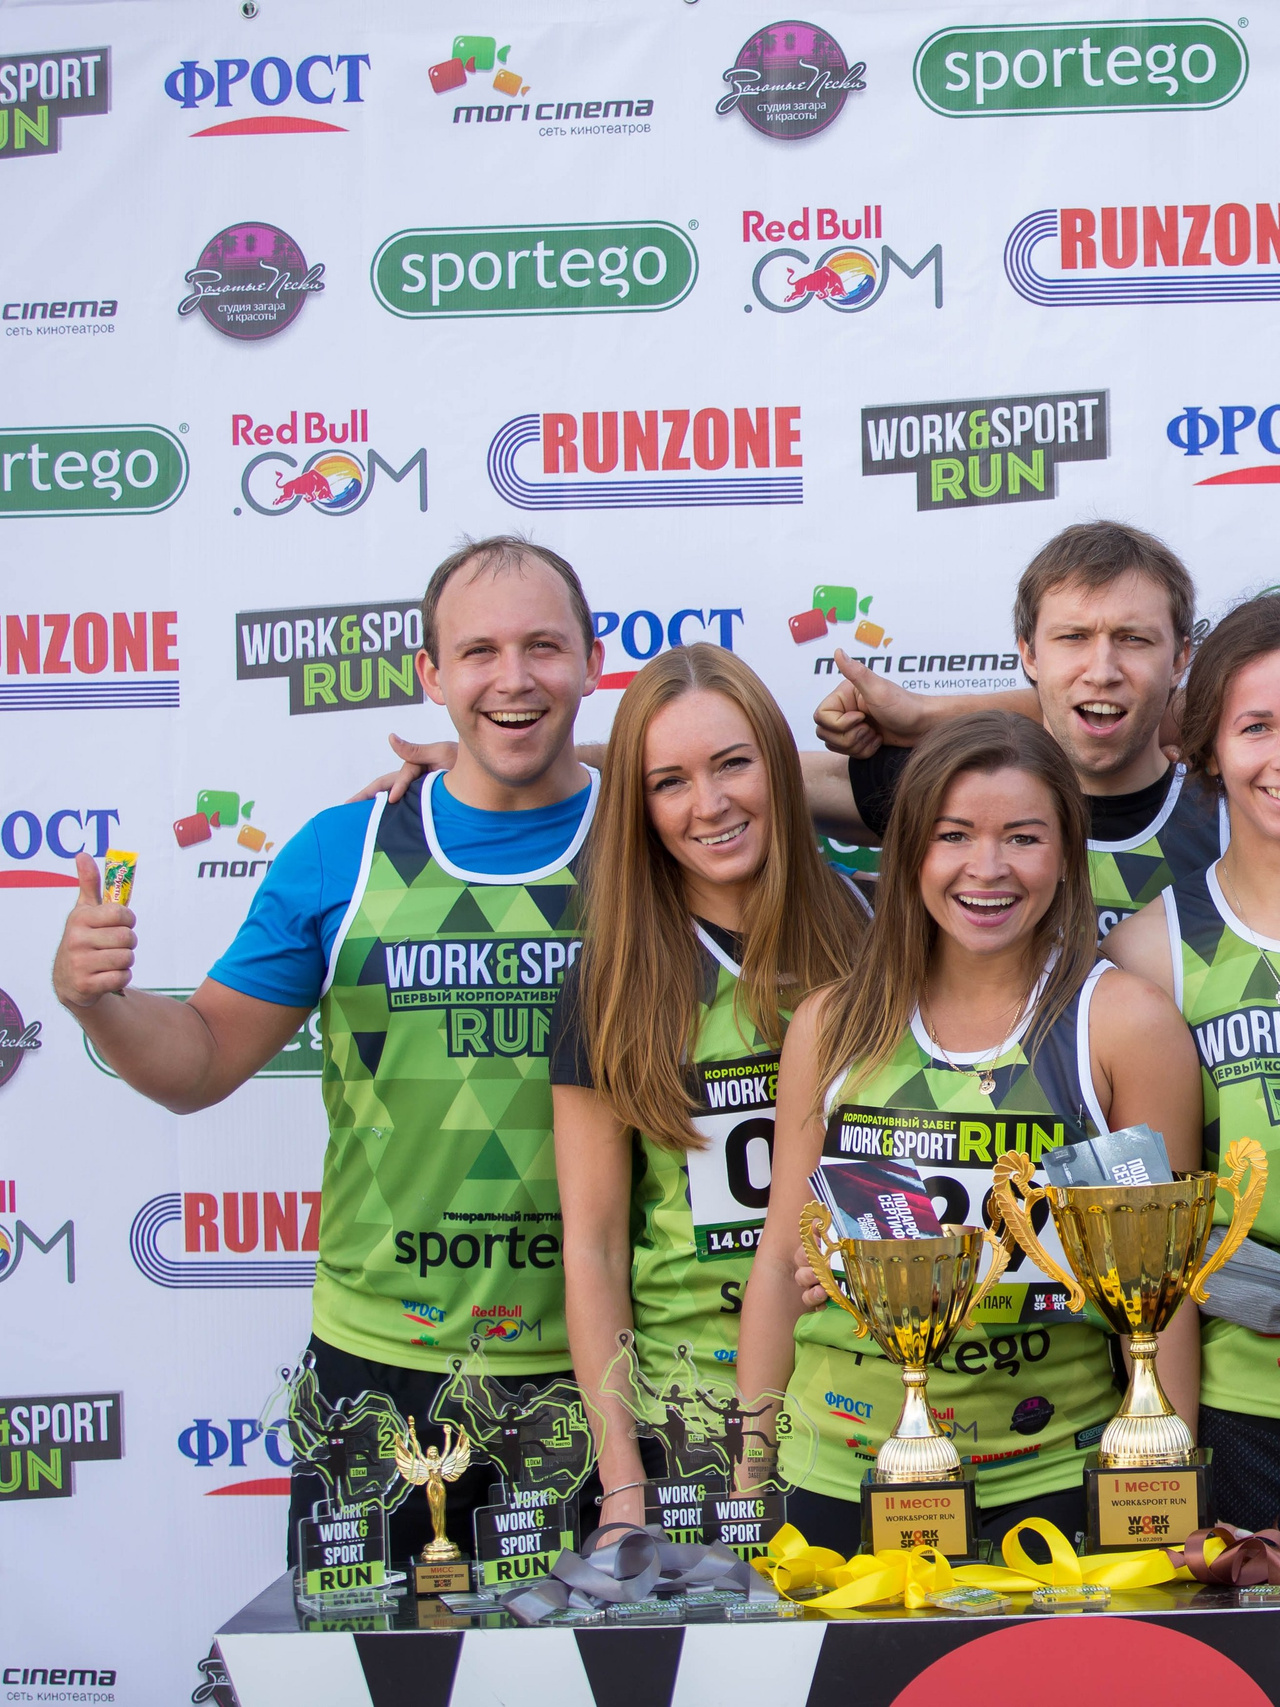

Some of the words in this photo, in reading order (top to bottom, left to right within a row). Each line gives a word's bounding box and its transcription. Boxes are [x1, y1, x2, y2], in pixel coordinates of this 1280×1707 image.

[0, 54, 101, 105] SPORT
[165, 53, 371, 110] ФРОСТ
[944, 37, 1218, 105] sportego
[453, 103, 530, 124] mori
[535, 99, 654, 121] cinema
[756, 101, 791, 113] студия
[793, 99, 827, 112] загара
[774, 110, 818, 122] красоты
[538, 126, 567, 138] сеть
[570, 122, 652, 138] кинотеатров
[742, 209, 810, 243] Red
[817, 205, 882, 241] Bull
[402, 239, 668, 307] sportego
[1, 298, 118, 321] cinema
[217, 303, 250, 316] студия
[252, 301, 286, 315] загара
[235, 310, 277, 323] красоты
[5, 326, 32, 338] сеть
[33, 322, 115, 340] кинотеатров
[232, 409, 298, 446] Red
[305, 408, 369, 445] Bull
[867, 398, 1099, 463] WORK&SPORT
[542, 405, 803, 474] RUNZONE
[2, 442, 159, 501] rtego
[931, 450, 1045, 502] RUN
[0, 610, 179, 675] NZONE
[241, 608, 424, 665] WORK&SPO
[898, 652, 1018, 674] cinema
[304, 655, 415, 707] RUN
[902, 678, 930, 690] сеть
[934, 676, 1016, 692] кинотеатров
[0, 808, 120, 860] ОСТ
[386, 941, 583, 988] WORK&SP
[394, 988, 451, 1005] ПЕРВЫЙ
[704, 1063, 780, 1080] КОРПОРАТИВ
[843, 1112, 920, 1129] КОРПОРАТИВНЫЙ
[922, 1119, 956, 1131] ЗАБЕГ
[840, 1125, 957, 1162] WORK&SPORT
[958, 1120, 1065, 1163] RUN
[184, 1191, 322, 1253] RUNZ
[394, 1226, 563, 1278] sporte
[471, 1305, 496, 1317] Red
[498, 1305, 522, 1317] Bull
[984, 1295, 1012, 1310] ПАРК
[825, 1391, 873, 1419] ФРОСТ
[658, 1484, 706, 1505] WORK&
[1111, 1499, 1164, 1508] WORK&SPORT
[1166, 1497, 1187, 1506] RUN
[495, 1509, 545, 1533] WORK&
[663, 1507, 702, 1528] SPORT
[716, 1500, 765, 1520] WORK&
[886, 1514, 938, 1522] WORK&SPORT
[940, 1513, 955, 1521] RUN
[319, 1519, 368, 1541] WORK&
[721, 1523, 761, 1543] SPORT
[324, 1544, 365, 1566] SPORT
[501, 1533, 542, 1555] SPORT
[320, 1566, 372, 1590] RUN
[497, 1556, 549, 1581] RUN
[2, 1667, 117, 1687] cinema
[6, 1692, 34, 1703] сеть
[37, 1691, 116, 1706] кинотеатров
